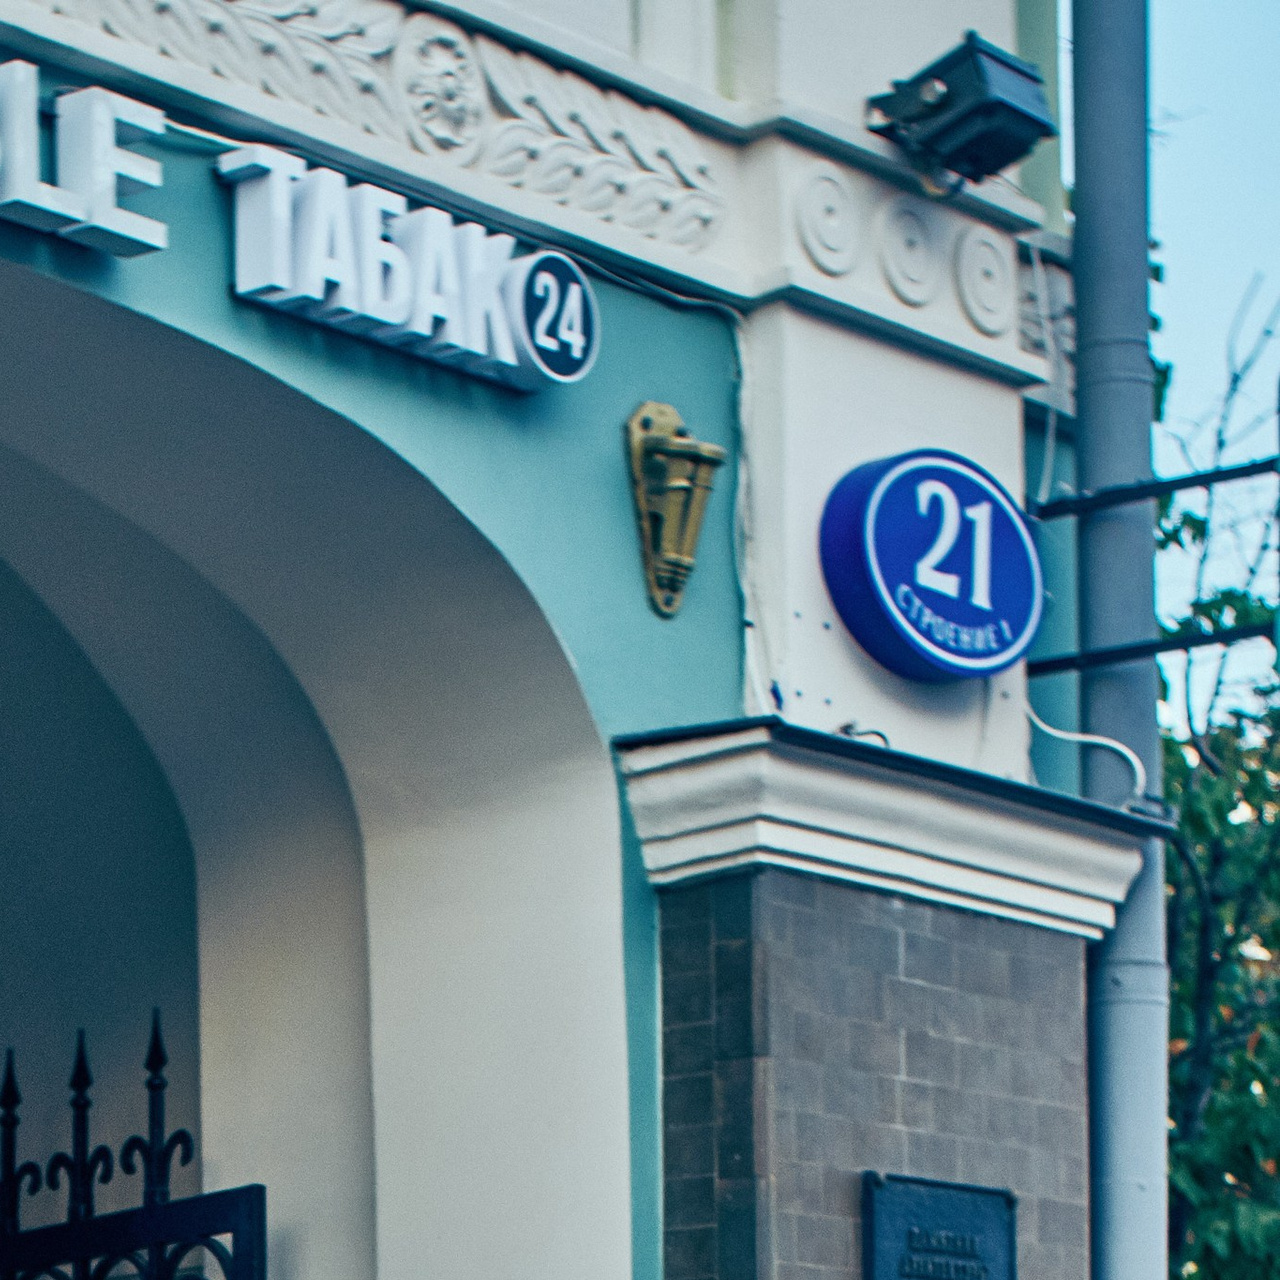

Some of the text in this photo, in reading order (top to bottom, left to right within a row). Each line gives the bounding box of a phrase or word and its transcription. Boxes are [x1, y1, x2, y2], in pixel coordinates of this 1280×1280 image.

[219, 143, 587, 370] ТАБАК 24
[915, 479, 993, 611] 21
